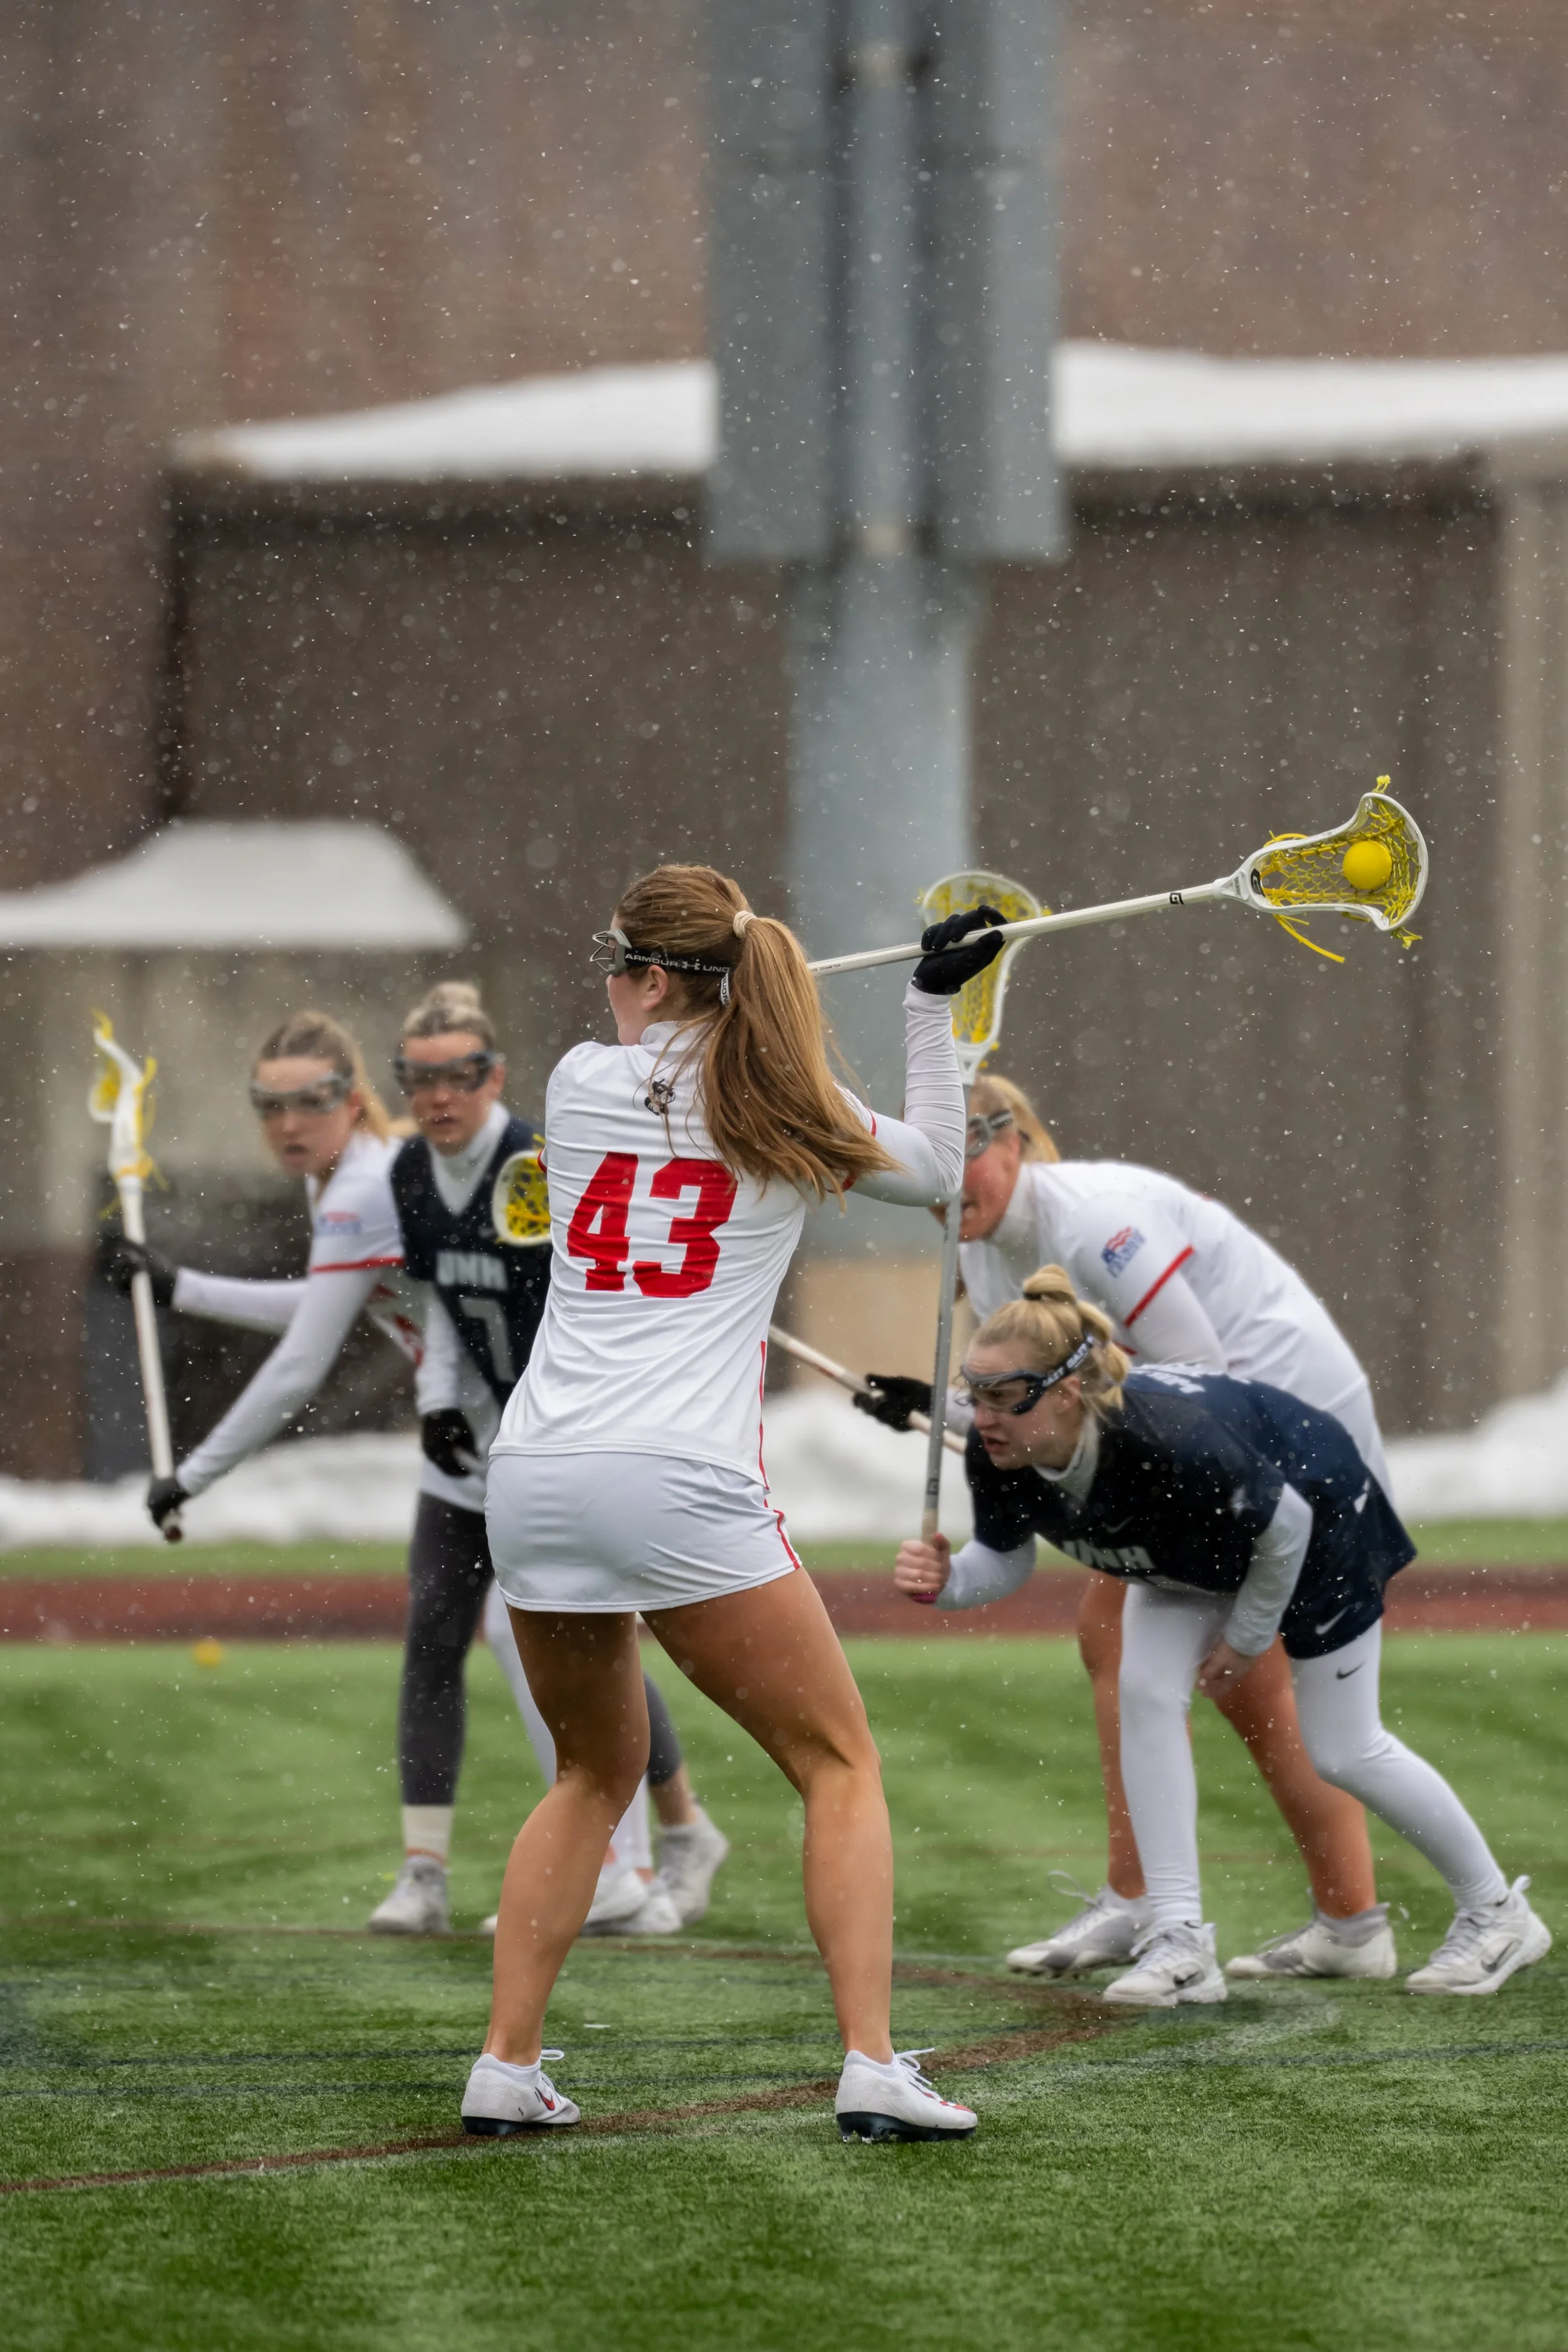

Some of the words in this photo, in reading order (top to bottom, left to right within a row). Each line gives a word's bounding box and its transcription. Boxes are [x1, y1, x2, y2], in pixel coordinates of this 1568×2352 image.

[625, 953, 679, 968] ARMOUR
[566, 1151, 739, 1298] 43
[458, 1296, 517, 1382] 7
[1062, 1539, 1156, 1569] UNH
